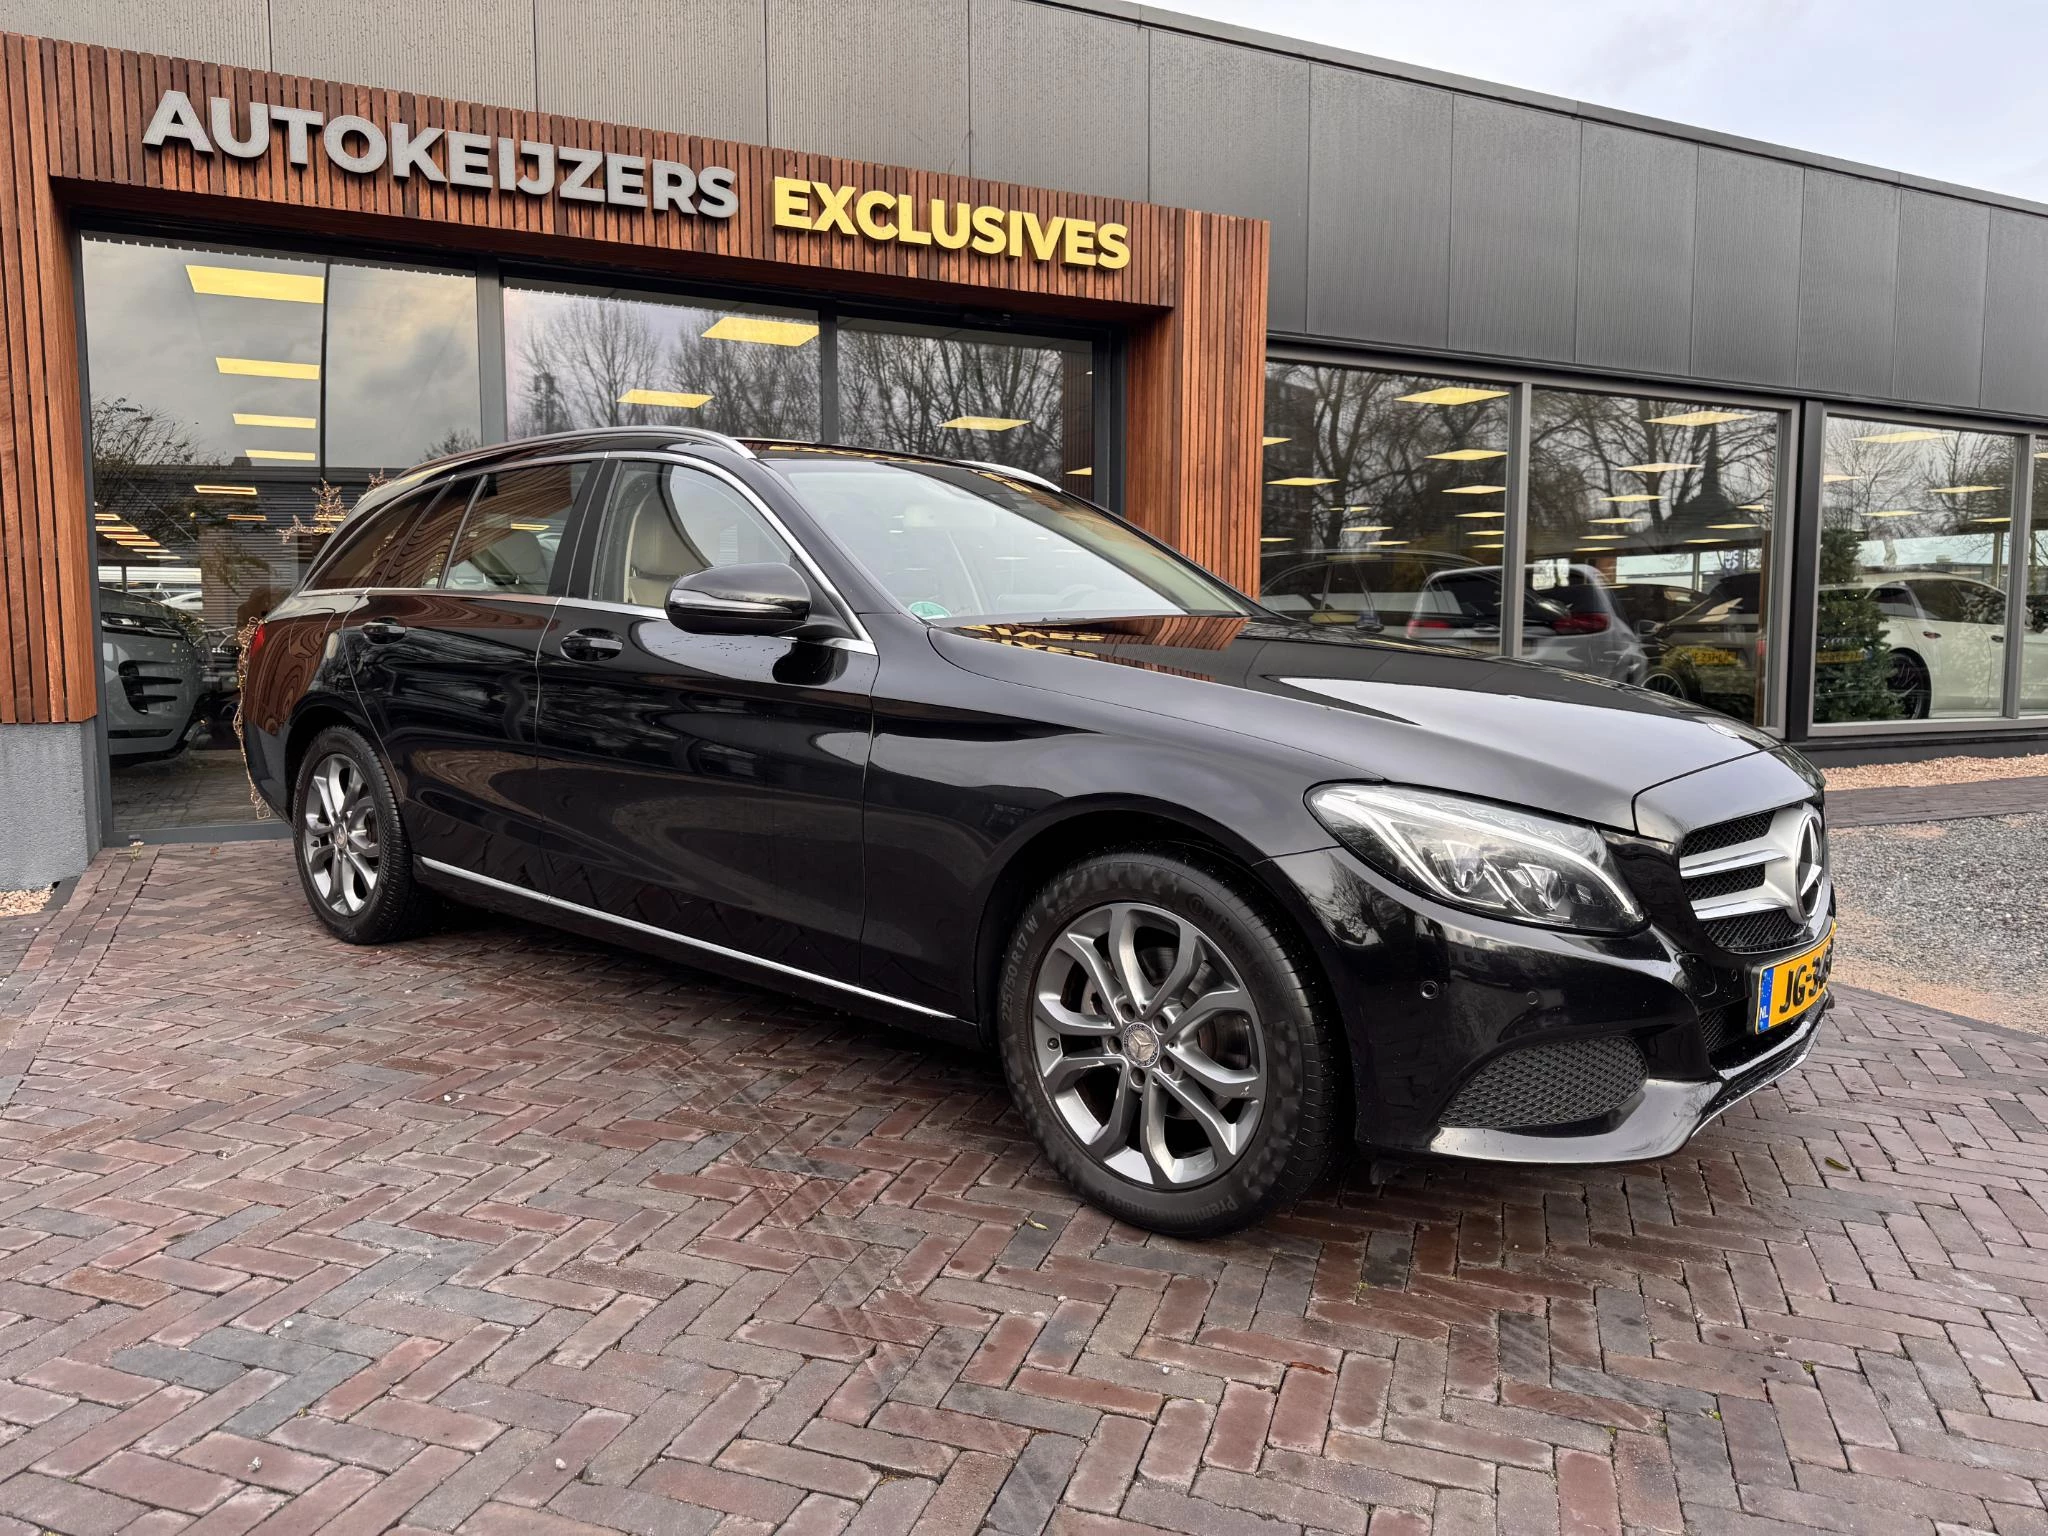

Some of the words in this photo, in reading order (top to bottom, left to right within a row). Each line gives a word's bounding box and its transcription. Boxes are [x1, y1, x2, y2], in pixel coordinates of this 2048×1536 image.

[142, 89, 740, 219] AUTOKEIJZERS
[773, 176, 1131, 270] EXCLUSIVES
[1759, 1006, 1769, 1020] NL
